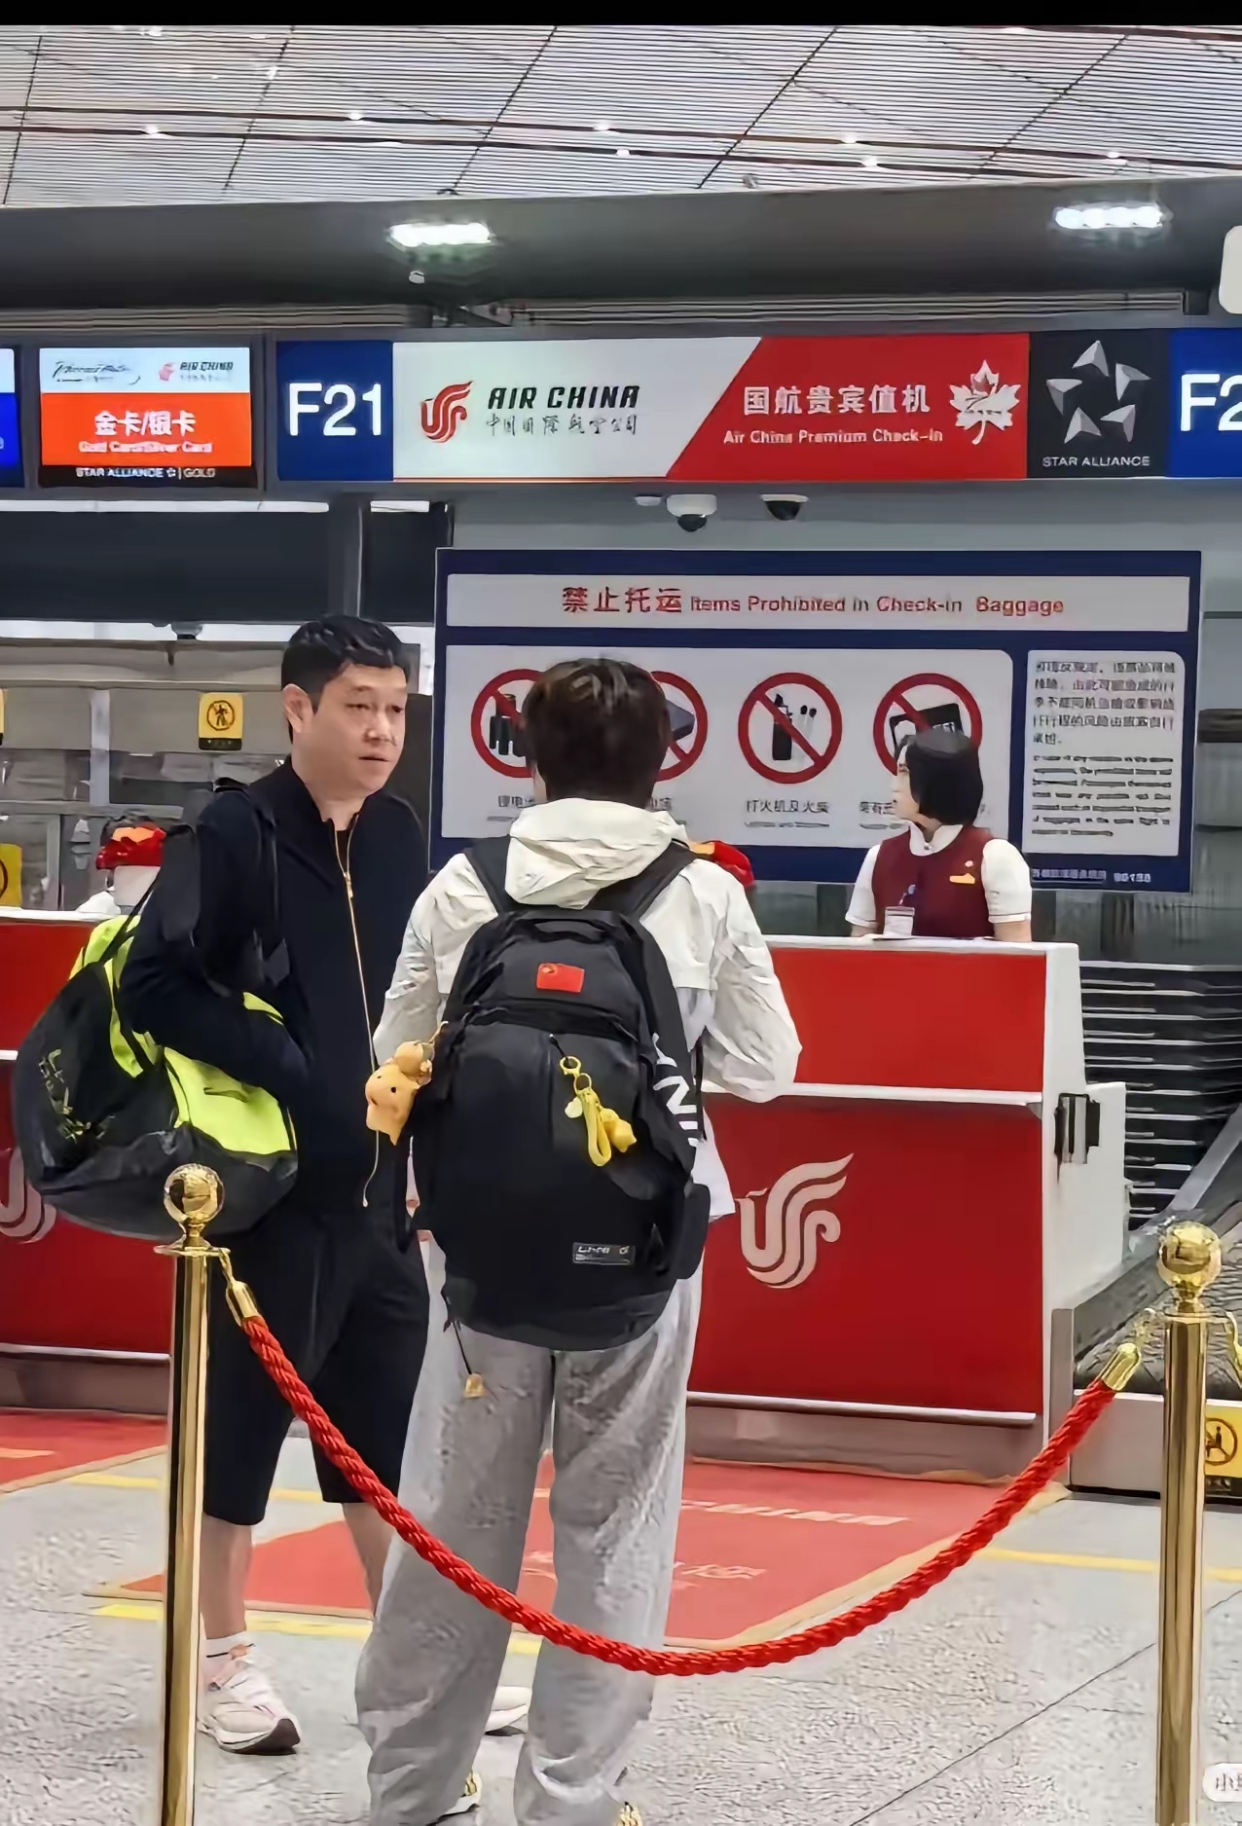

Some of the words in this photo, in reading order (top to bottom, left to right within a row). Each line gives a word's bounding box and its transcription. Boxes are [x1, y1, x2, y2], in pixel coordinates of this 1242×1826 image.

[288, 382, 382, 436] F21
[488, 387, 537, 409] AIR
[547, 386, 640, 409] CHINA
[743, 384, 930, 415] 国航贵宾值机
[723, 430, 745, 443] Air
[750, 430, 793, 443] China
[798, 429, 867, 443] Premium
[1043, 456, 1078, 467] STAR
[1081, 456, 1150, 467] ALLIANCE
[562, 587, 682, 613] 禁止托运
[690, 596, 741, 612] Items
[748, 595, 846, 612] Prohibited
[876, 595, 963, 612] Check-in
[976, 596, 1064, 616] Baggage
